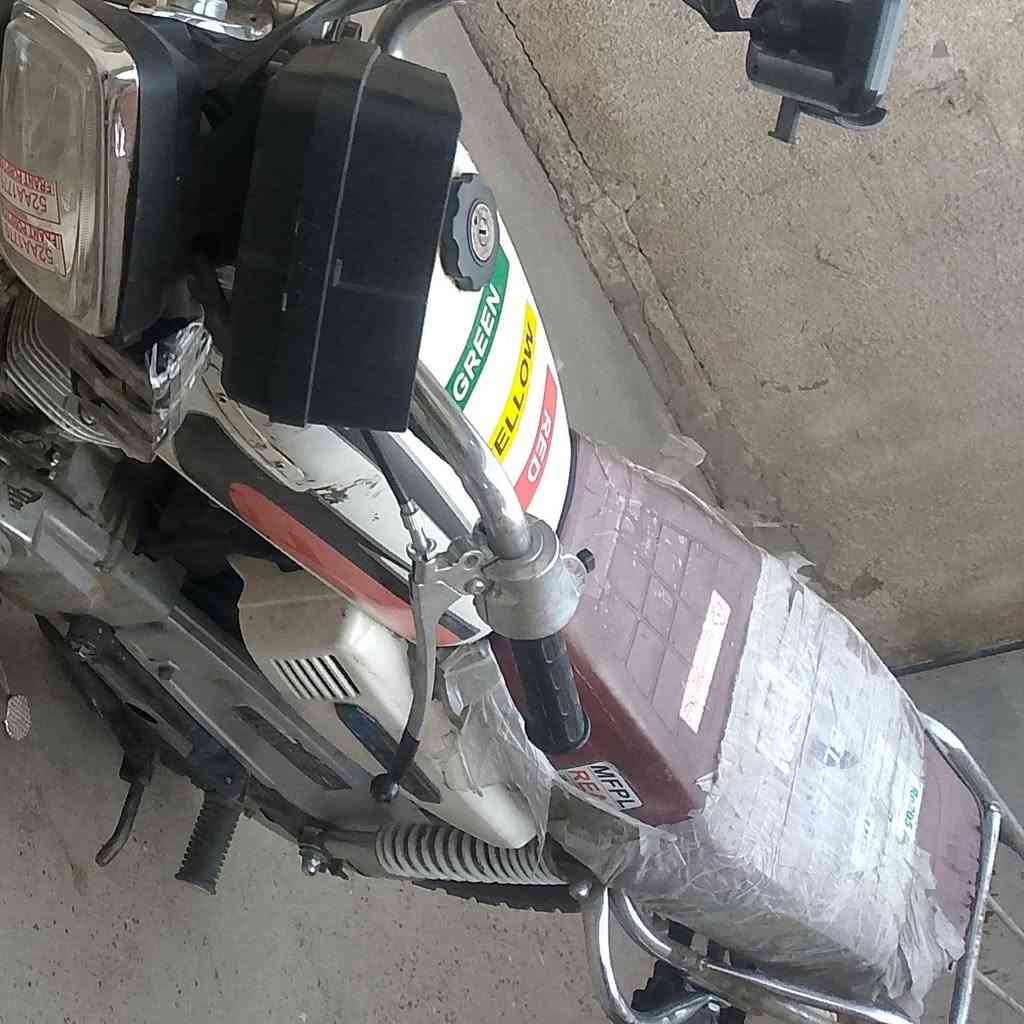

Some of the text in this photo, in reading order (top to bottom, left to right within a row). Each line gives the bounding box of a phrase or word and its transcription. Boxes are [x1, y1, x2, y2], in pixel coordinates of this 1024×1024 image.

[453, 282, 500, 401] GREEN
[493, 322, 534, 457] ELLOW
[527, 409, 552, 484] RED
[591, 765, 636, 808] MFPL
